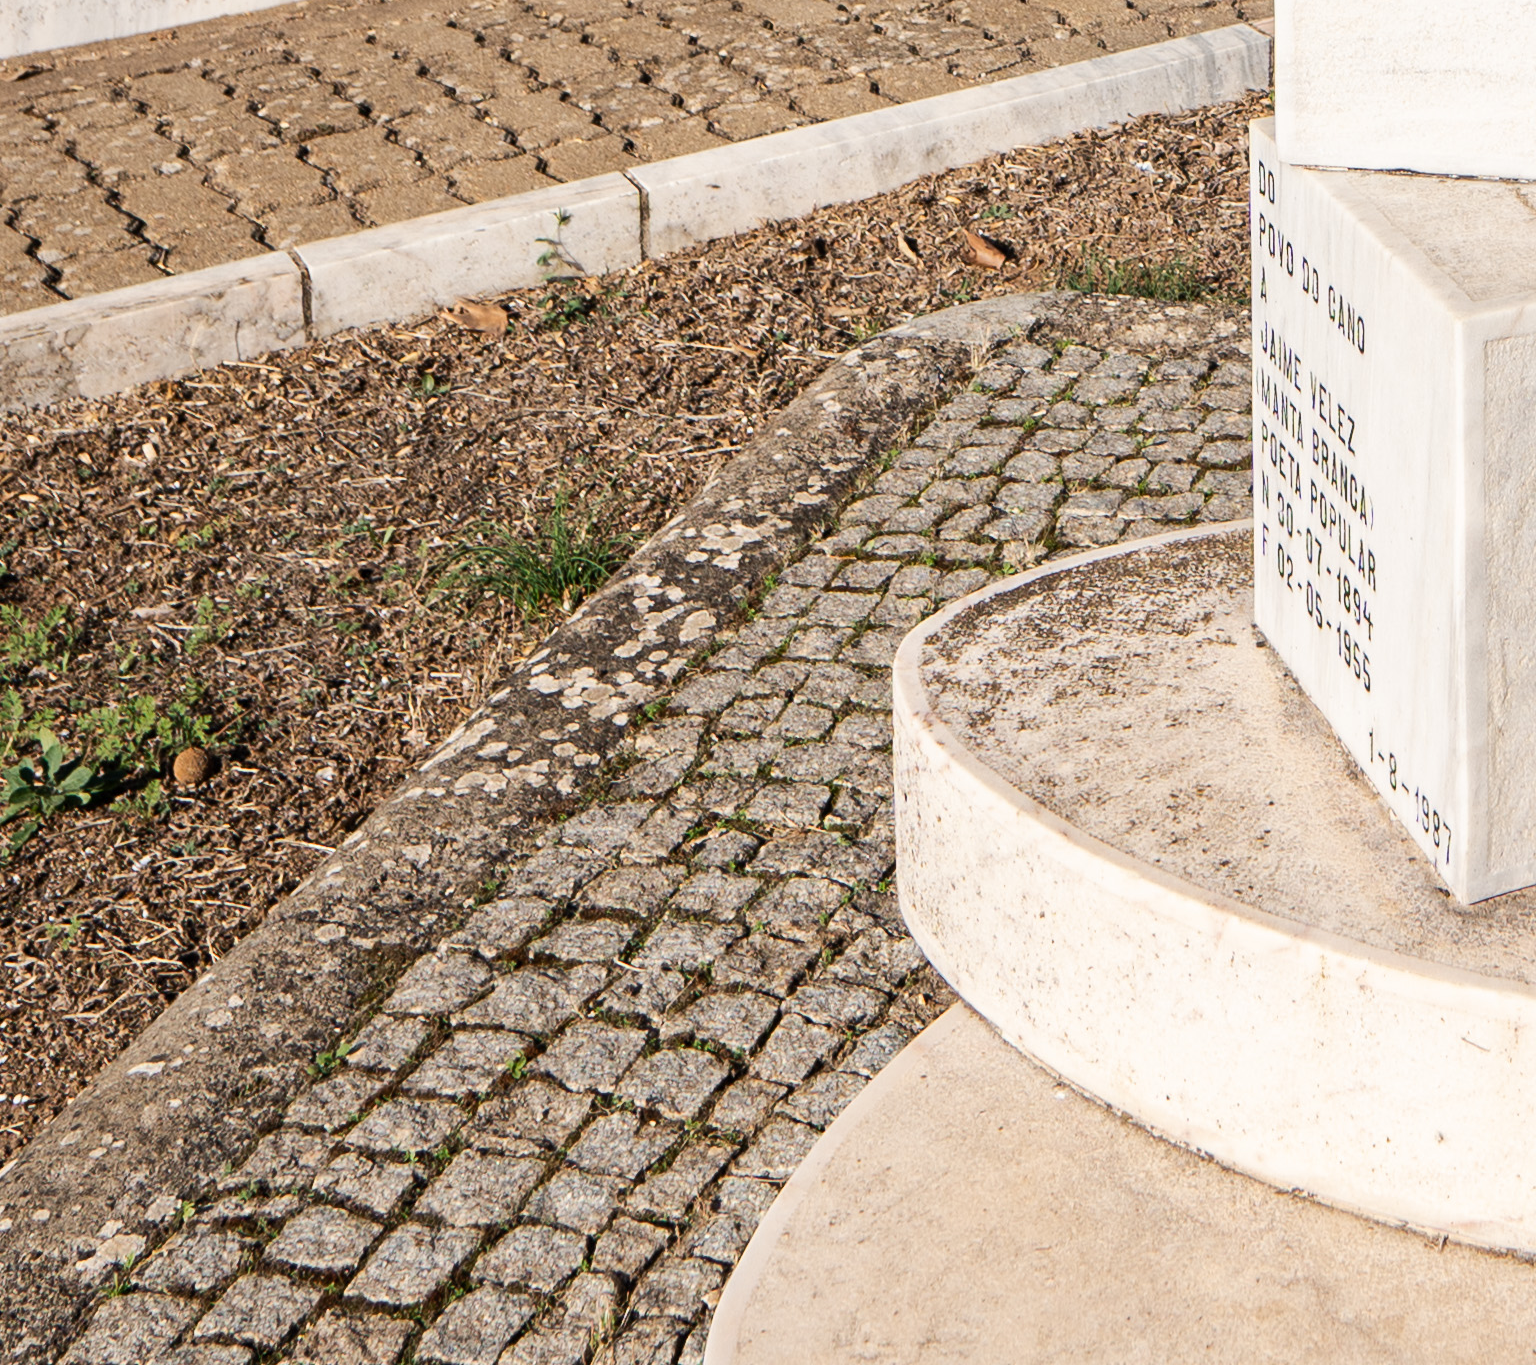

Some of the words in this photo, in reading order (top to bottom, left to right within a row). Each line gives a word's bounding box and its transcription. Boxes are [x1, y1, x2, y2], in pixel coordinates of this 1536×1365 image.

[1258, 159, 1276, 205] DO
[1258, 212, 1294, 280] POVO
[1301, 256, 1320, 305] DO
[1328, 284, 1365, 355] CANO
[1259, 266, 1268, 304] A
[1255, 366, 1304, 449] (MANTA
[1312, 428, 1374, 527] BRANCA)
[1260, 320, 1302, 393] JAIME
[1310, 371, 1356, 457] VELEZ
[1261, 419, 1302, 500] POETA
[1310, 479, 1378, 591] POPULAR
[1261, 469, 1270, 510] N
[1277, 491, 1373, 642] 30-07-1894
[1262, 522, 1270, 556] F
[1277, 543, 1372, 693] 02-05-1955
[1368, 726, 1453, 866] 1-8-1987
